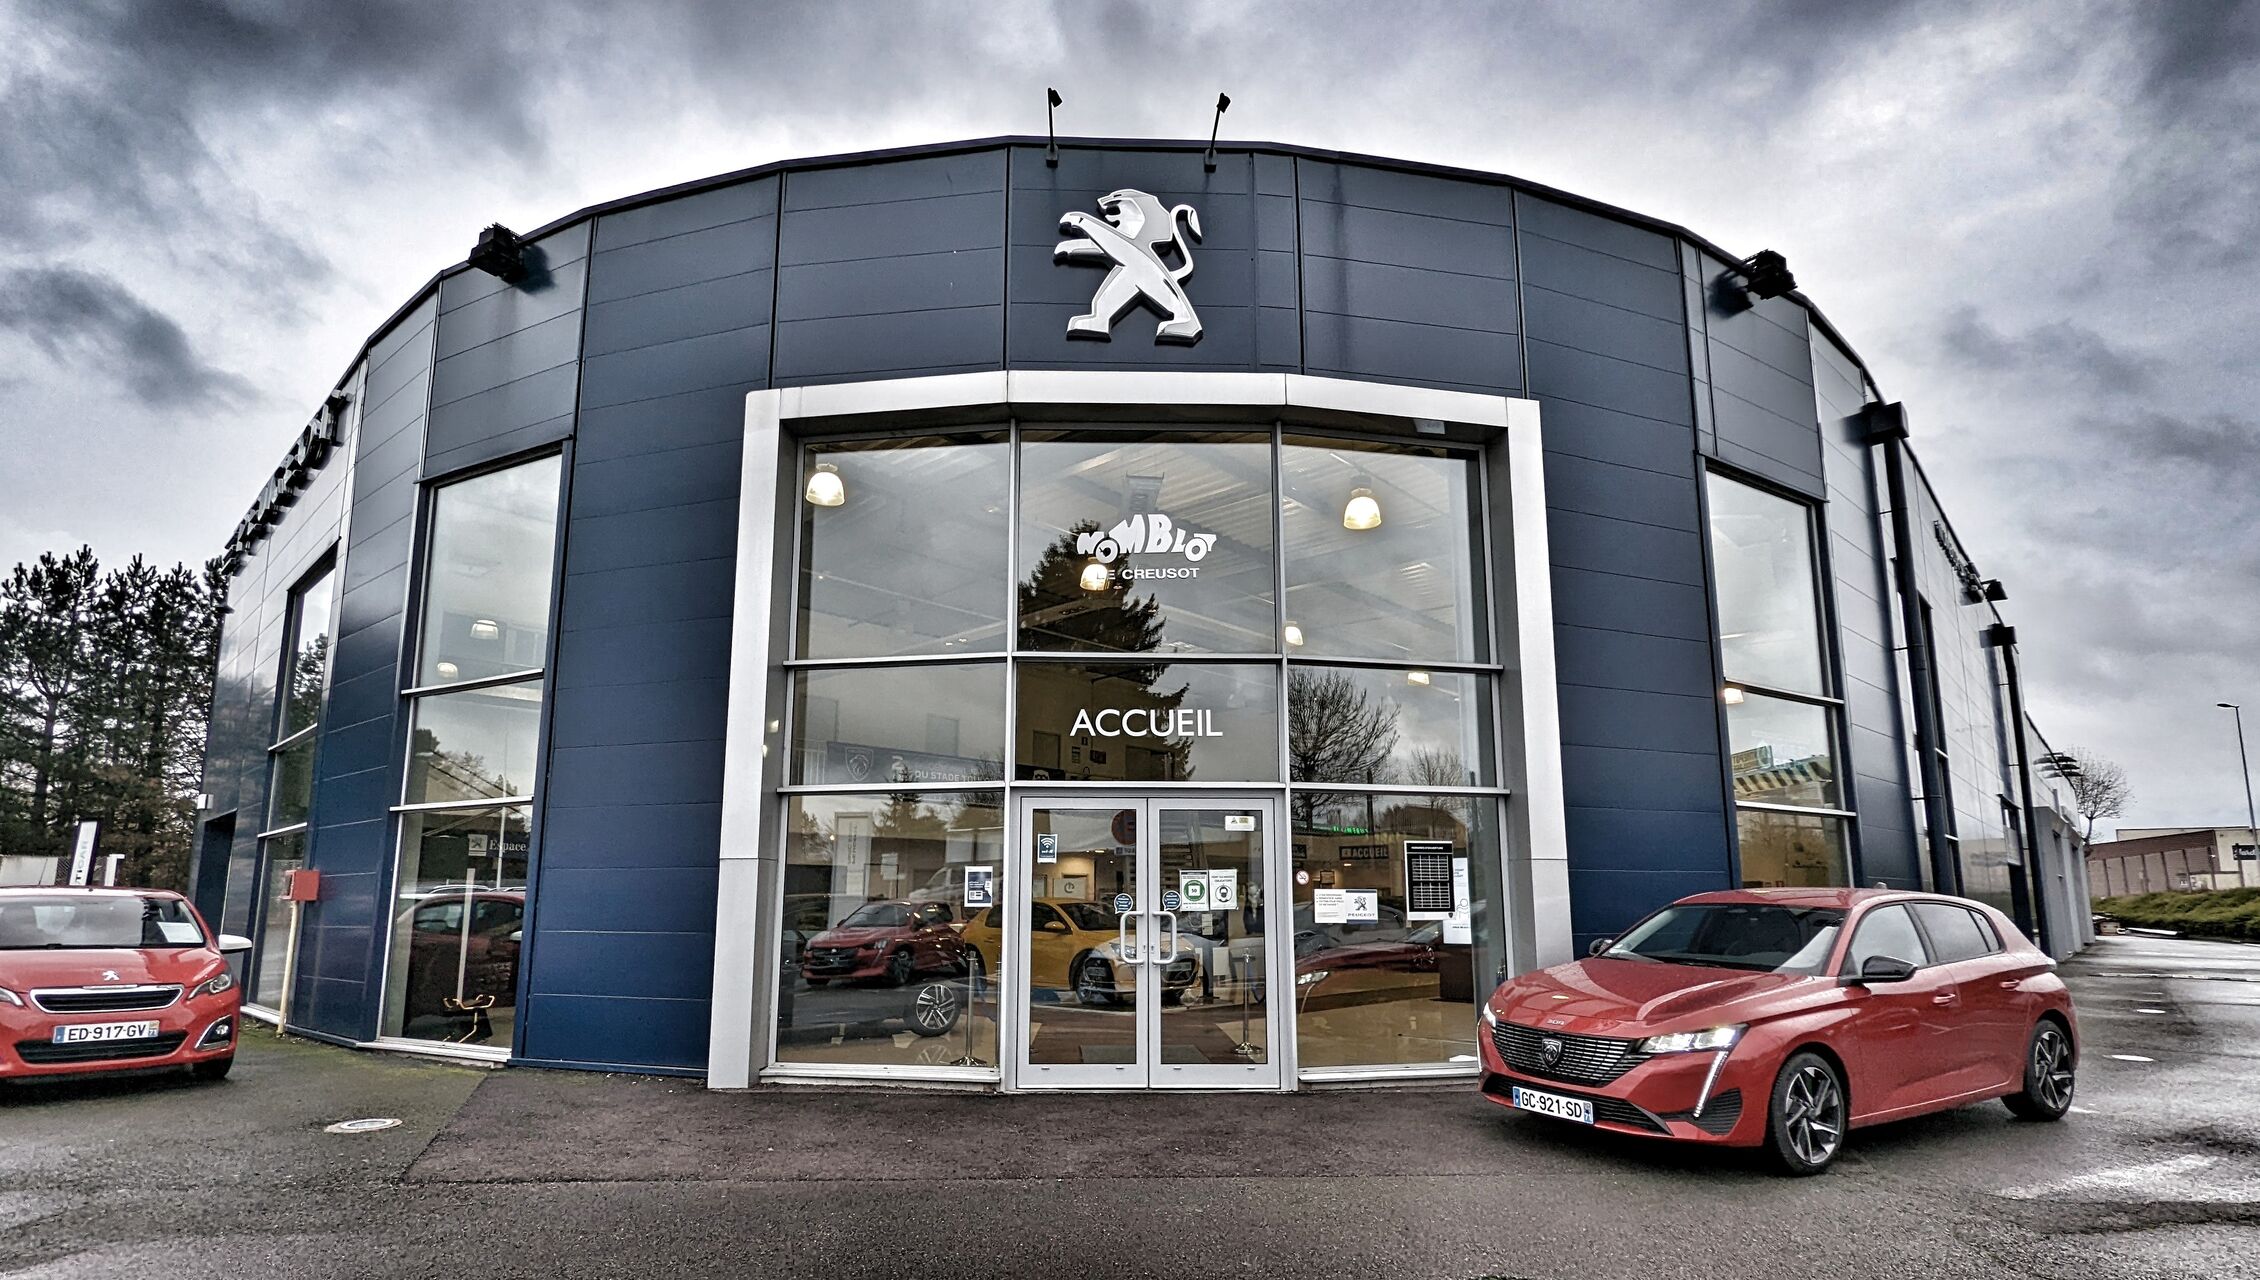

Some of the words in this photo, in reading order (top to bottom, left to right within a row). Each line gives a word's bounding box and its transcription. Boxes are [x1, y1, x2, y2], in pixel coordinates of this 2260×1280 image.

[1076, 513, 1217, 564] NOMBLOT
[1122, 567, 1200, 580] CREUSOT
[1069, 708, 1224, 738] ACCUEIL
[930, 772, 960, 781] STADE
[1352, 847, 1388, 858] ACCUEIL
[68, 1024, 147, 1041] ED-917-GV
[1521, 1091, 1582, 1118] GC-921-SD
